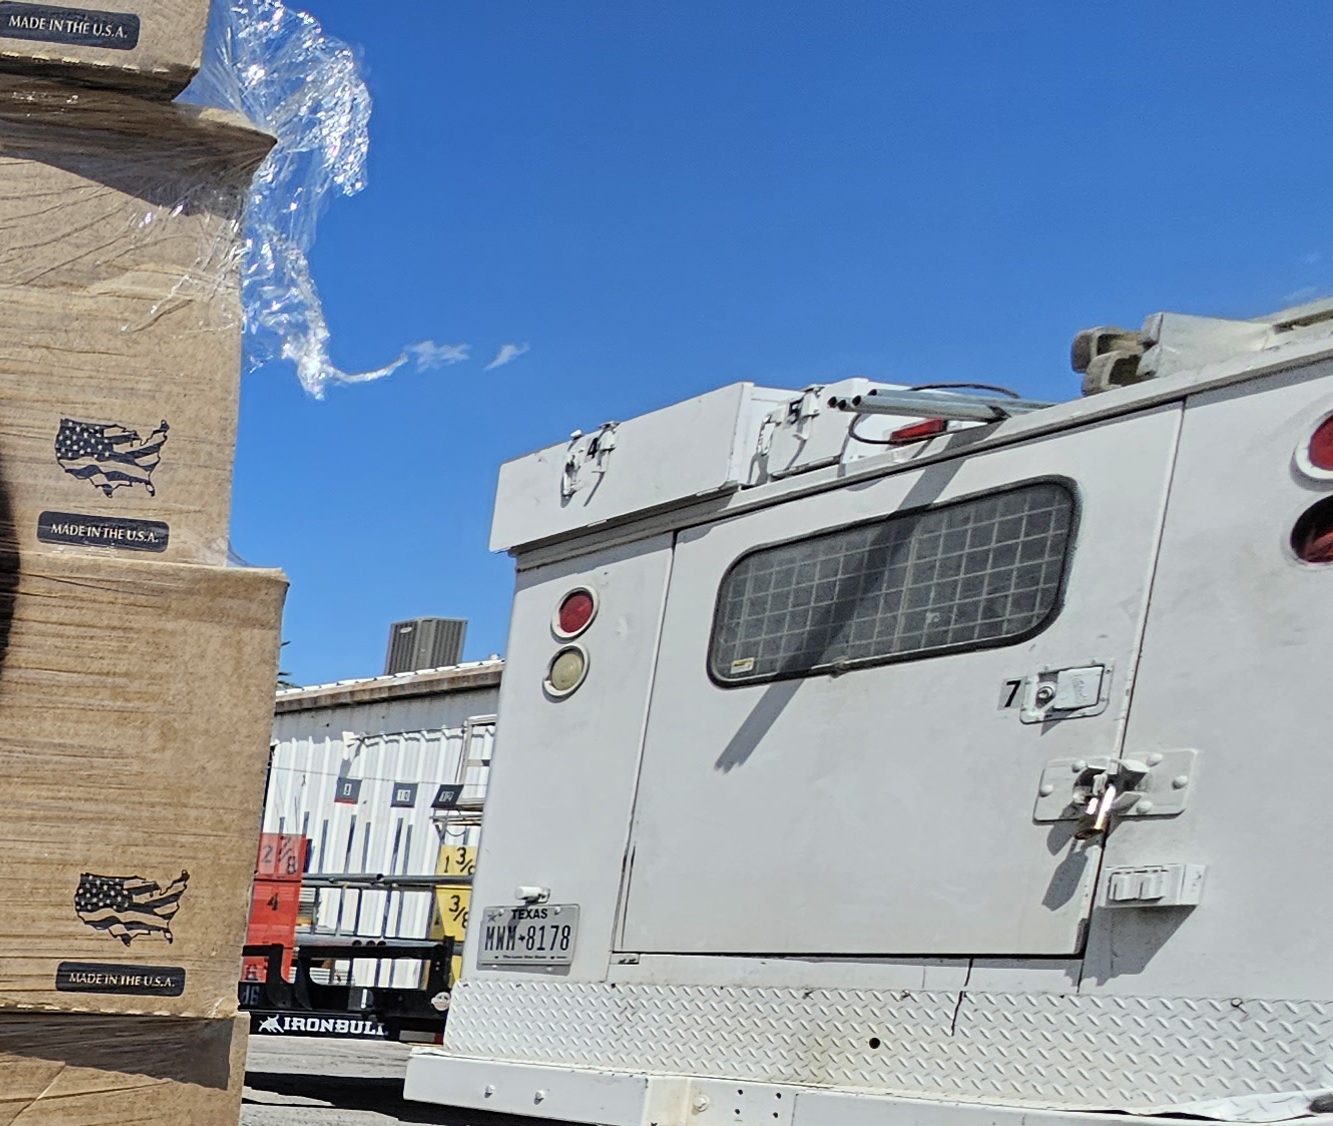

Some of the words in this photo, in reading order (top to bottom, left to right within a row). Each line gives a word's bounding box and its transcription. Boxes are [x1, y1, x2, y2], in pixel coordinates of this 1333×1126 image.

[8, 14, 45, 30] MADE
[49, 16, 62, 32] IN
[65, 18, 90, 34] THE
[93, 23, 128, 38] U.S.A.
[51, 523, 86, 537] MADE
[87, 526, 102, 538] IN
[103, 528, 124, 540] THE
[127, 529, 159, 543] U.S.A.
[1004, 680, 1022, 708] 7
[267, 893, 279, 911] 4
[511, 908, 548, 920] TEXAS
